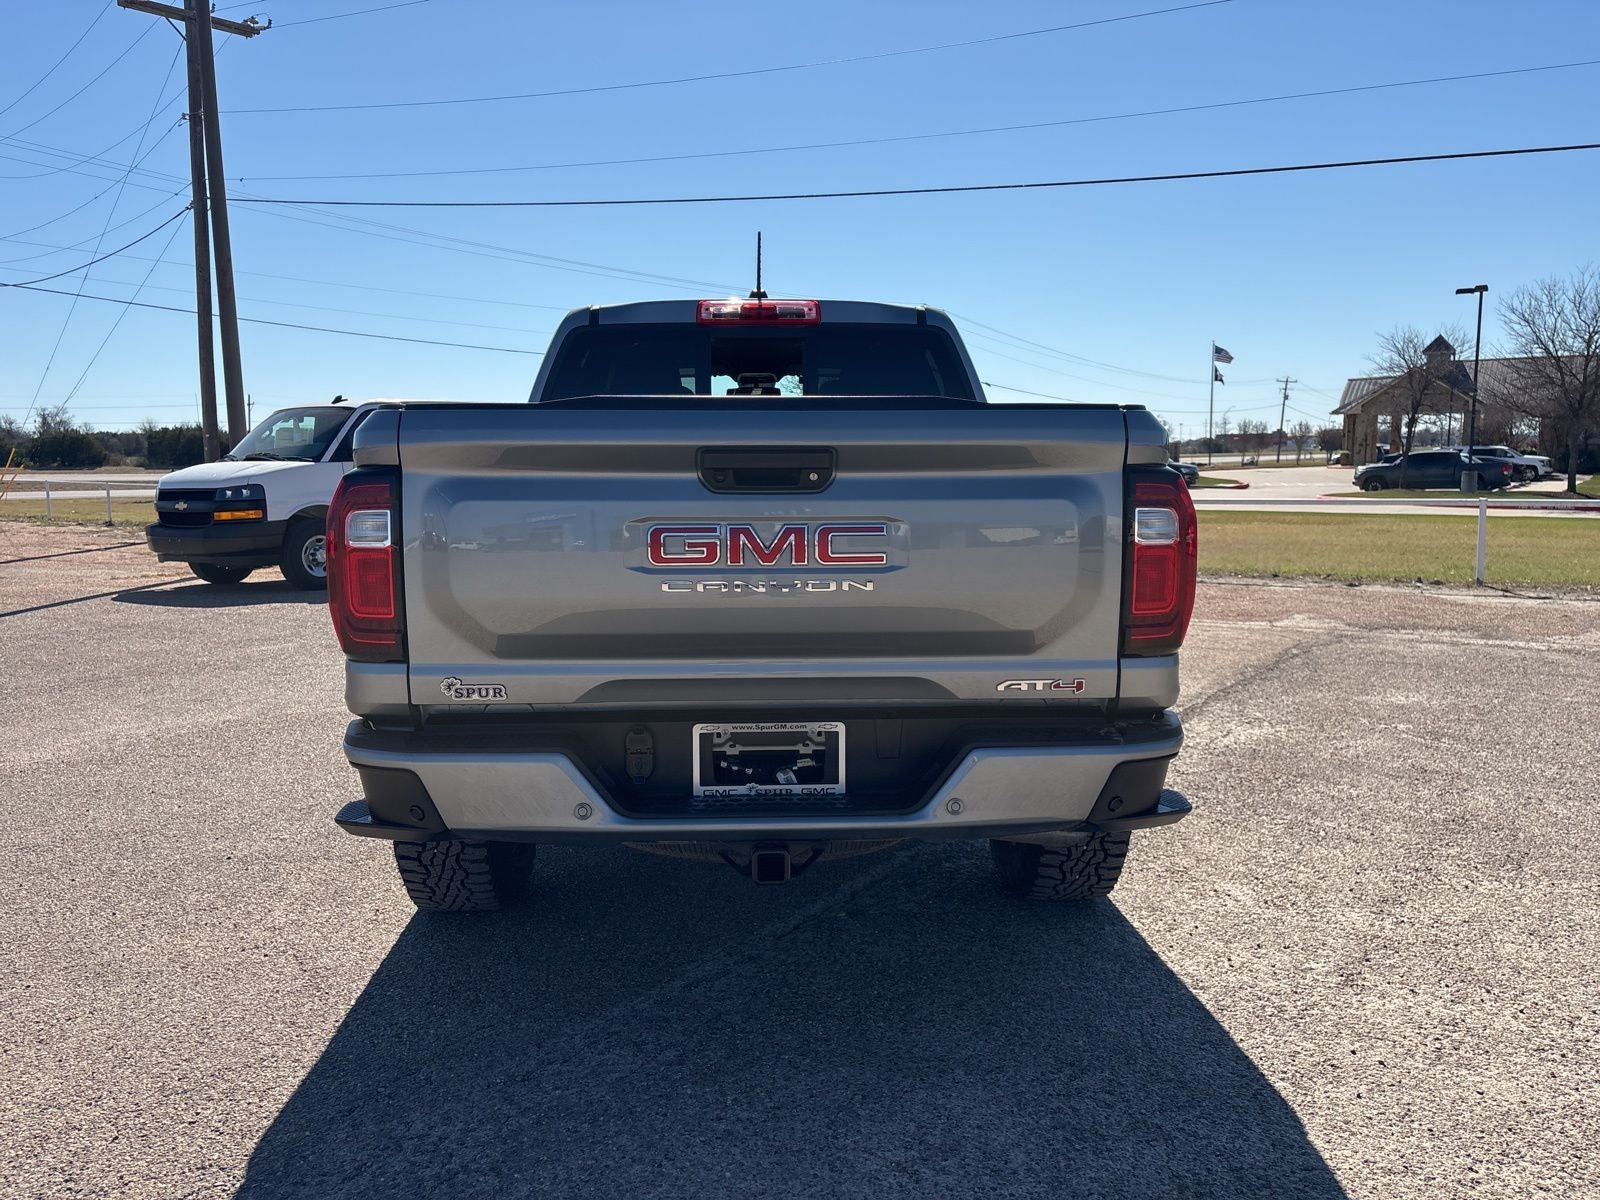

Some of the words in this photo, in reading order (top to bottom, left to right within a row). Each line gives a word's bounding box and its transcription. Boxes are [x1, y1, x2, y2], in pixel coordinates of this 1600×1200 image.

[648, 524, 887, 566] GMC
[661, 579, 875, 593] CANYON
[454, 687, 504, 699] SPUR
[996, 679, 1086, 694] AT4
[731, 723, 808, 731] www.SpurGM.com
[703, 789, 738, 797] GMC
[800, 787, 837, 796] GMC
